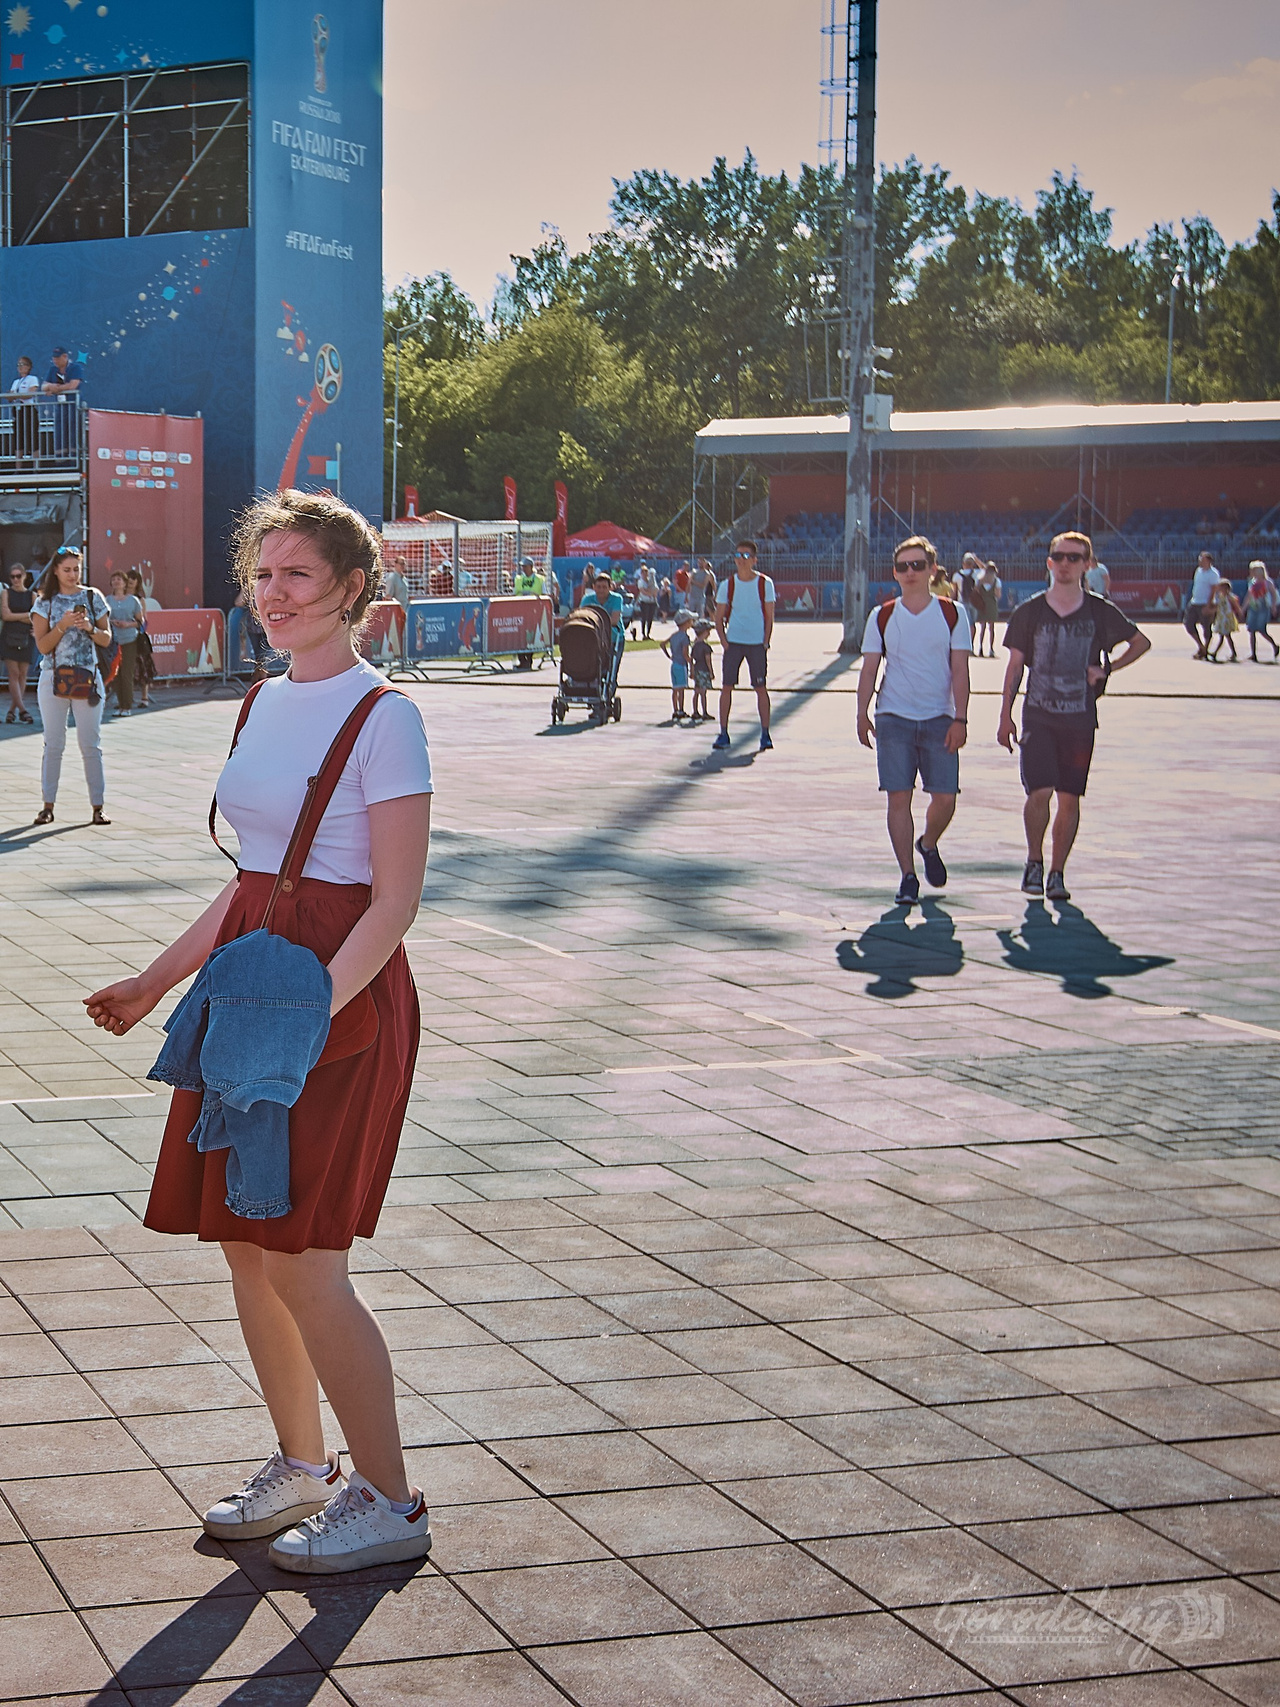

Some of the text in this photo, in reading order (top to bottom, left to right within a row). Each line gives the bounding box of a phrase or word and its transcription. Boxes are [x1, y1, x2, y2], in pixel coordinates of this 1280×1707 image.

[272, 120, 368, 167] FIFA FAN FEST
[291, 153, 351, 183] EKATERINBURG
[285, 230, 354, 261] #FIFAFanFest
[153, 633, 167, 645] FAN
[167, 632, 184, 645] FEST
